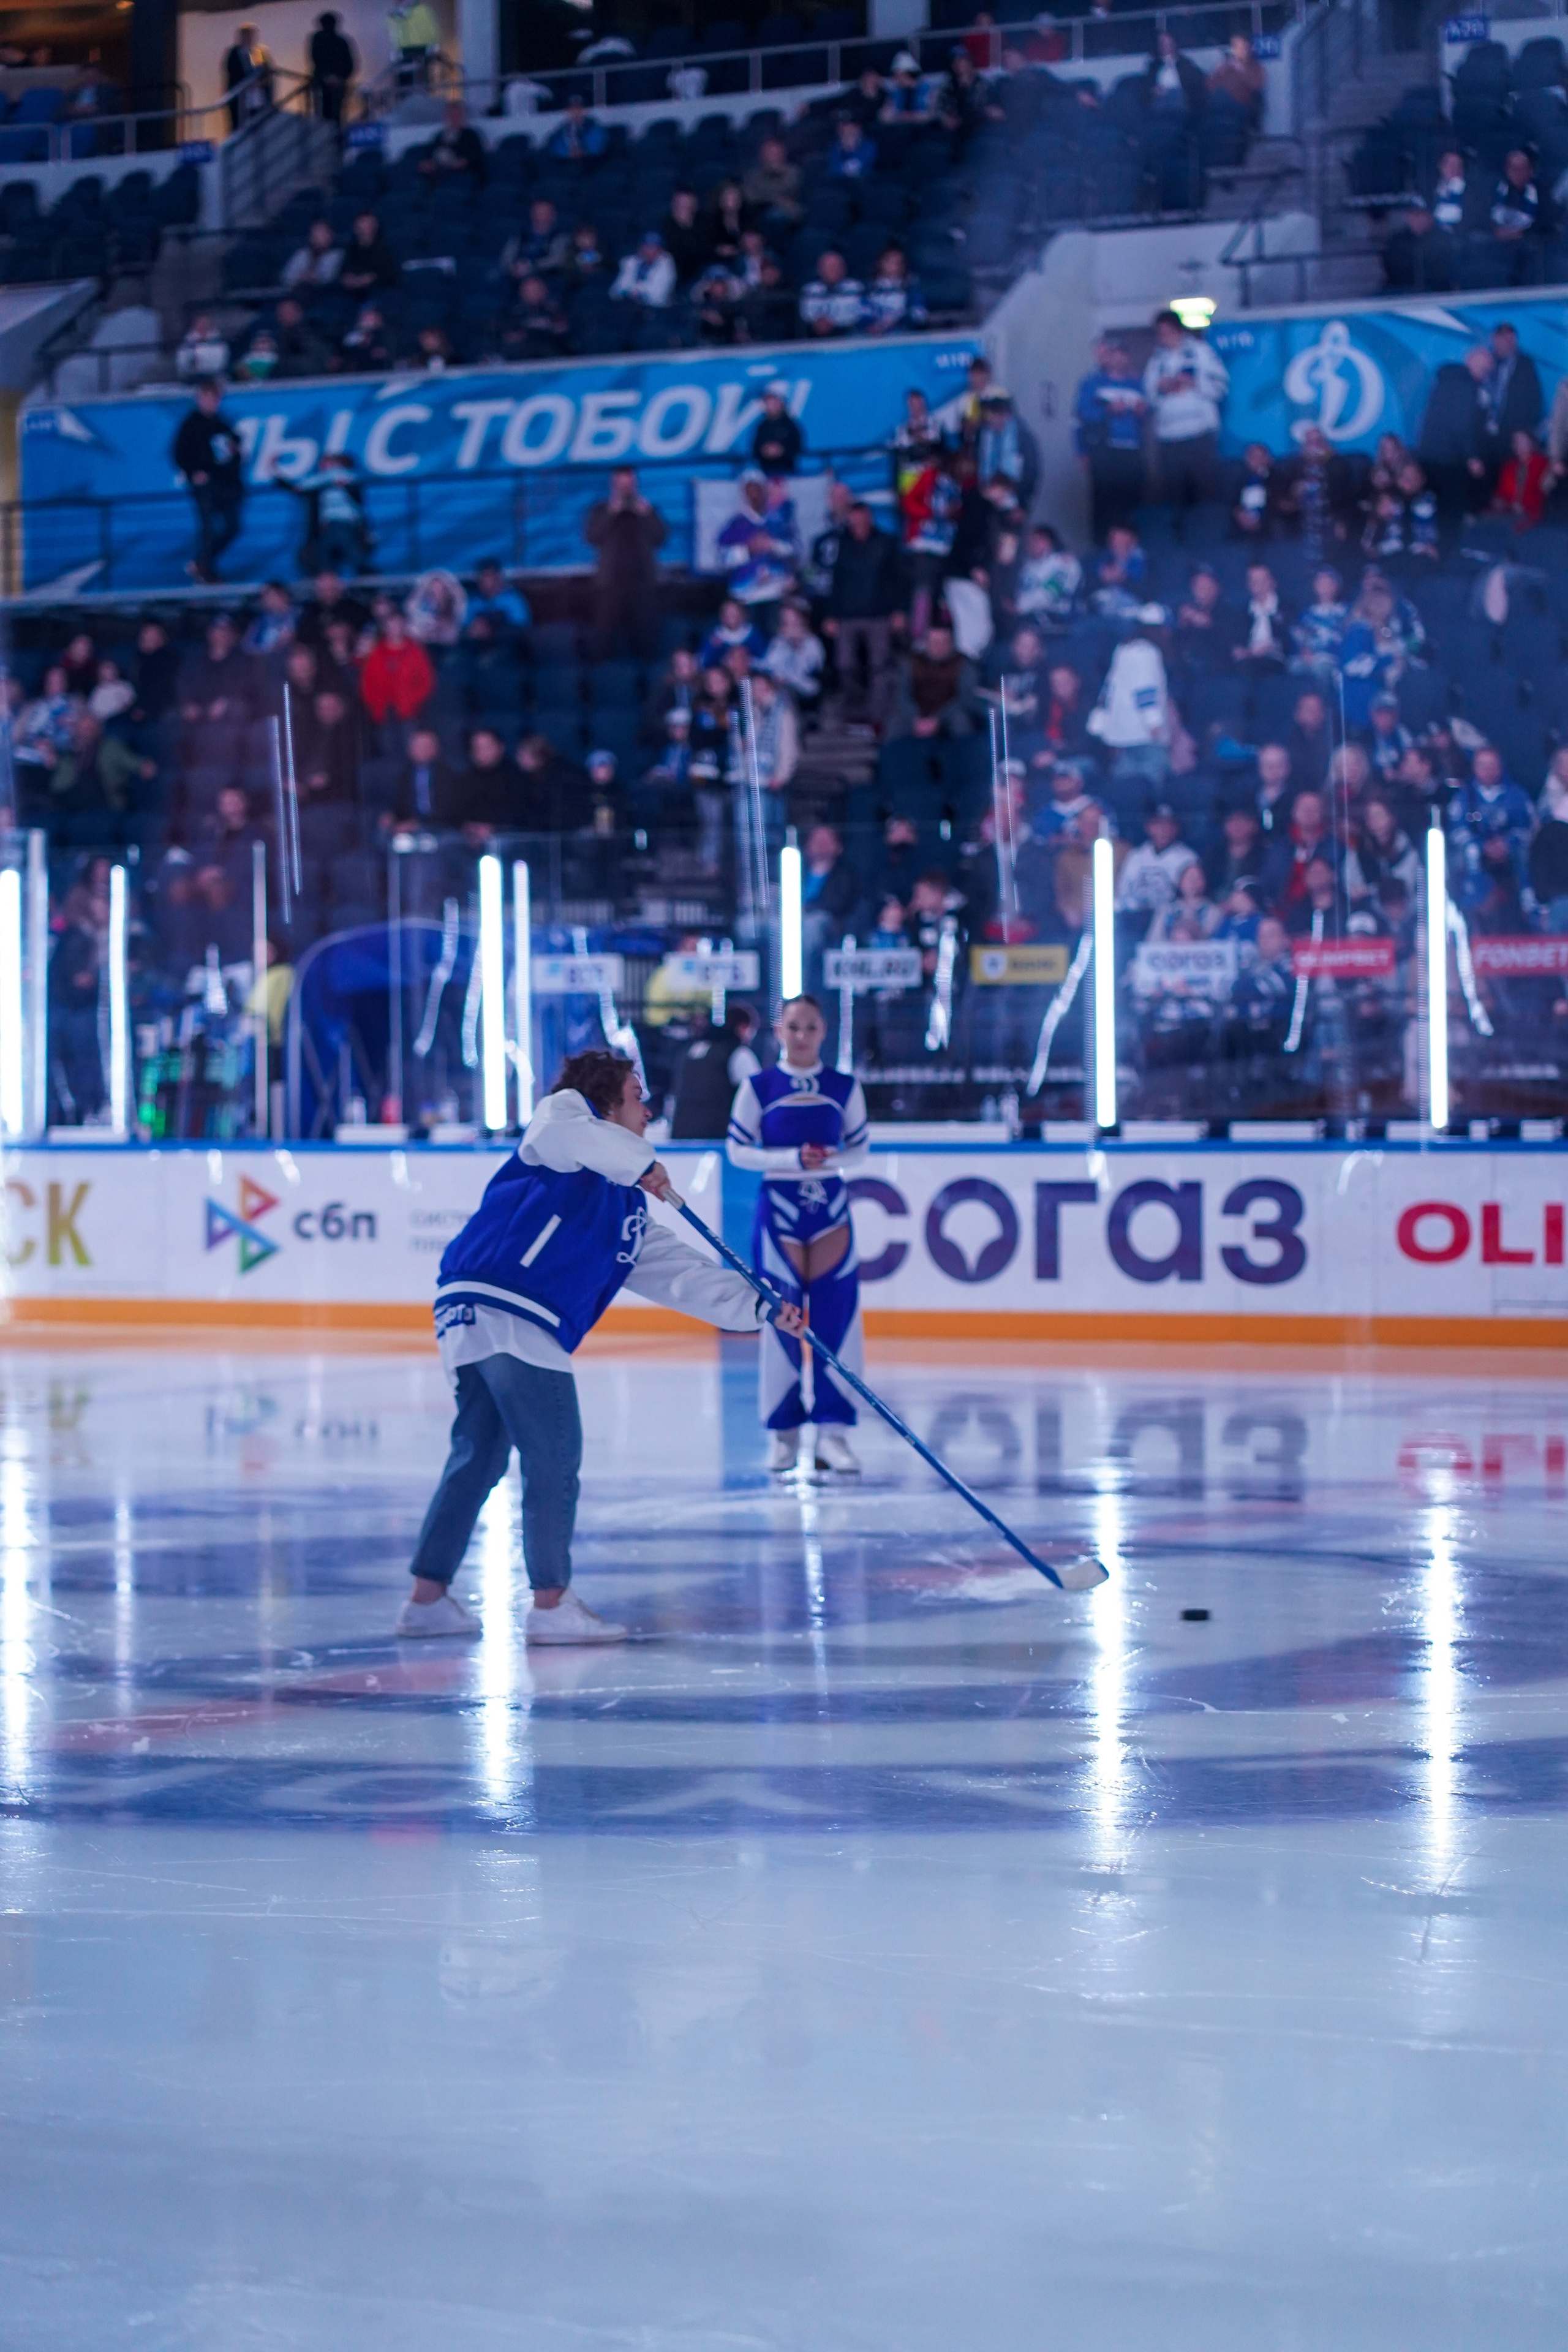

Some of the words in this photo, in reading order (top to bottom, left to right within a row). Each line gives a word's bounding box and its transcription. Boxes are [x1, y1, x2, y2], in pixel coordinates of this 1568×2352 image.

[364, 404, 432, 475] С
[451, 364, 812, 469] ТОБОЙ
[1395, 1200, 1565, 1267] OLI
